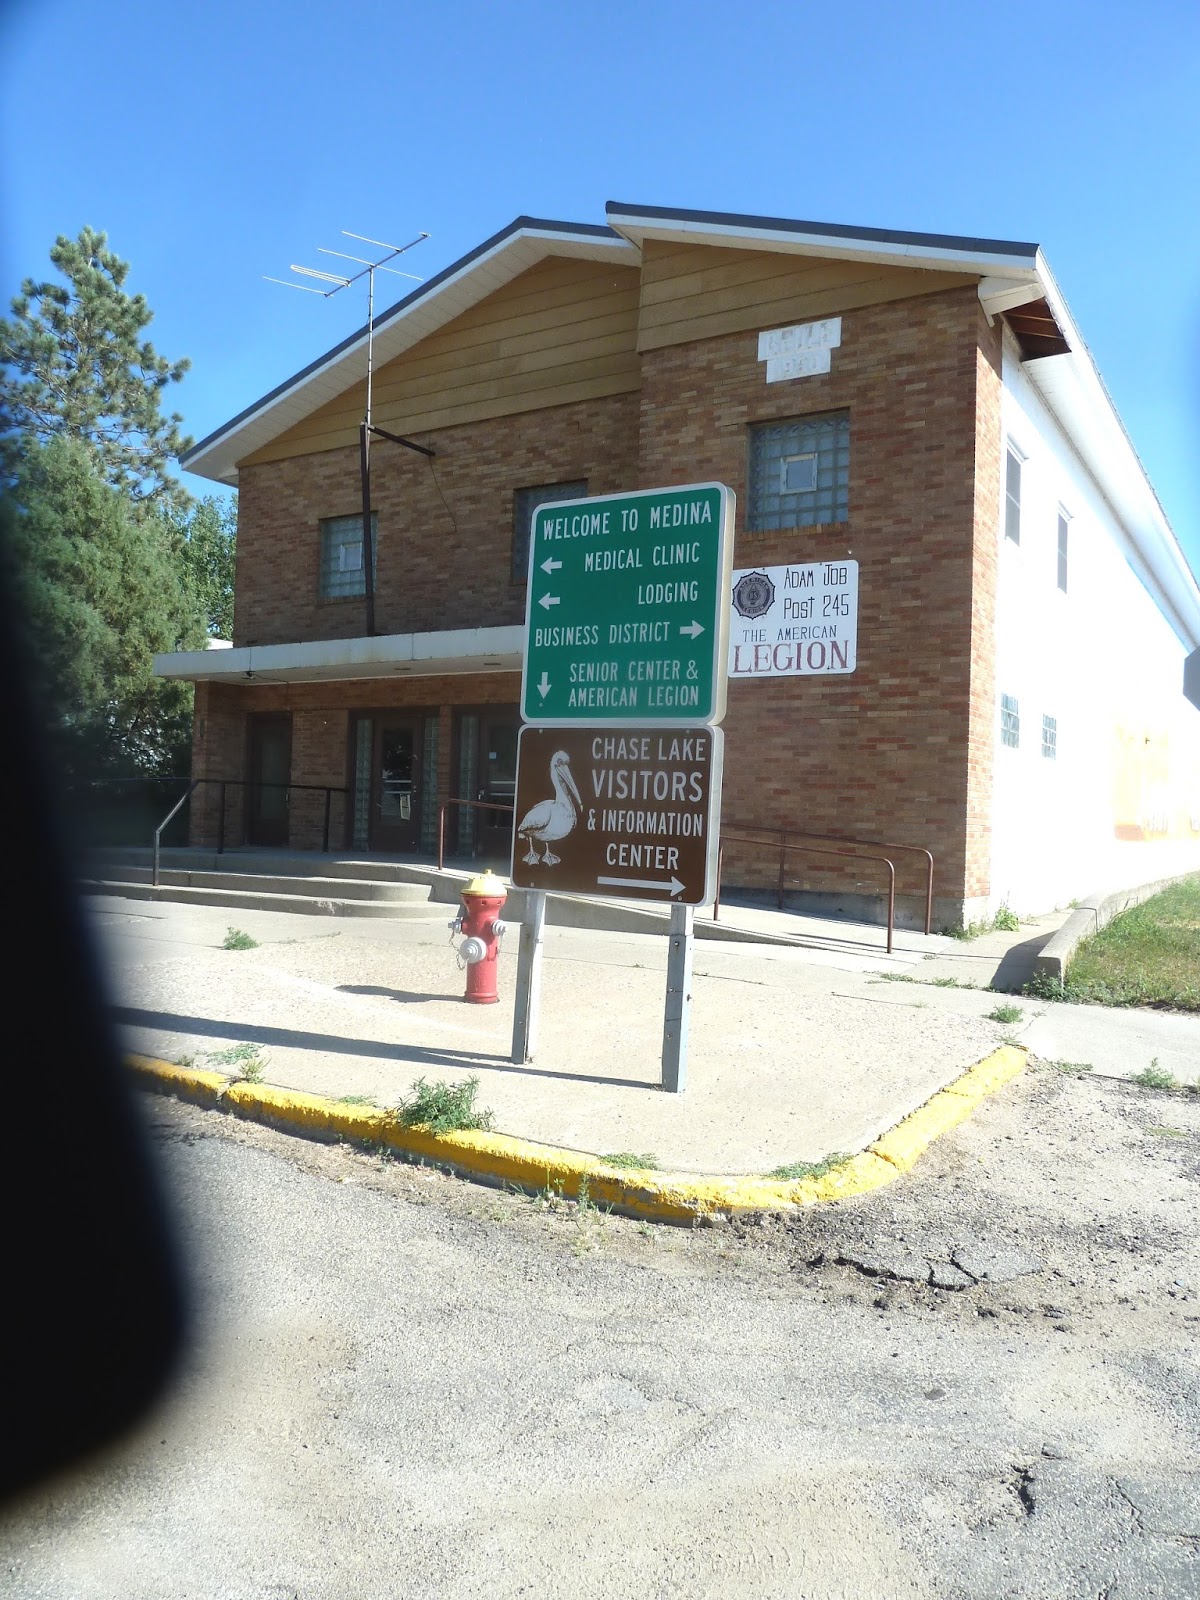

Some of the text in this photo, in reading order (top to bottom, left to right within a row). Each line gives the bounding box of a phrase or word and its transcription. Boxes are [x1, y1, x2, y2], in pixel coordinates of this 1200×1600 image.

[543, 500, 712, 541] WELCOME TO MEDINA
[584, 542, 700, 572] MEDICAL CLINIC
[638, 580, 698, 605] LODGING
[822, 593, 849, 617] 245
[535, 621, 670, 647] BUSINESS DISTRICT
[743, 625, 837, 642] THE AMERICAN
[733, 640, 849, 674] LEGION
[569, 659, 699, 683] SENIOR CENTER &
[568, 685, 699, 707] AMERICAN LEGION
[592, 737, 706, 762] CHASE LAKE
[592, 769, 703, 802] VISITORS
[587, 808, 703, 837] & INFORMATION
[606, 843, 679, 870] CENTER
